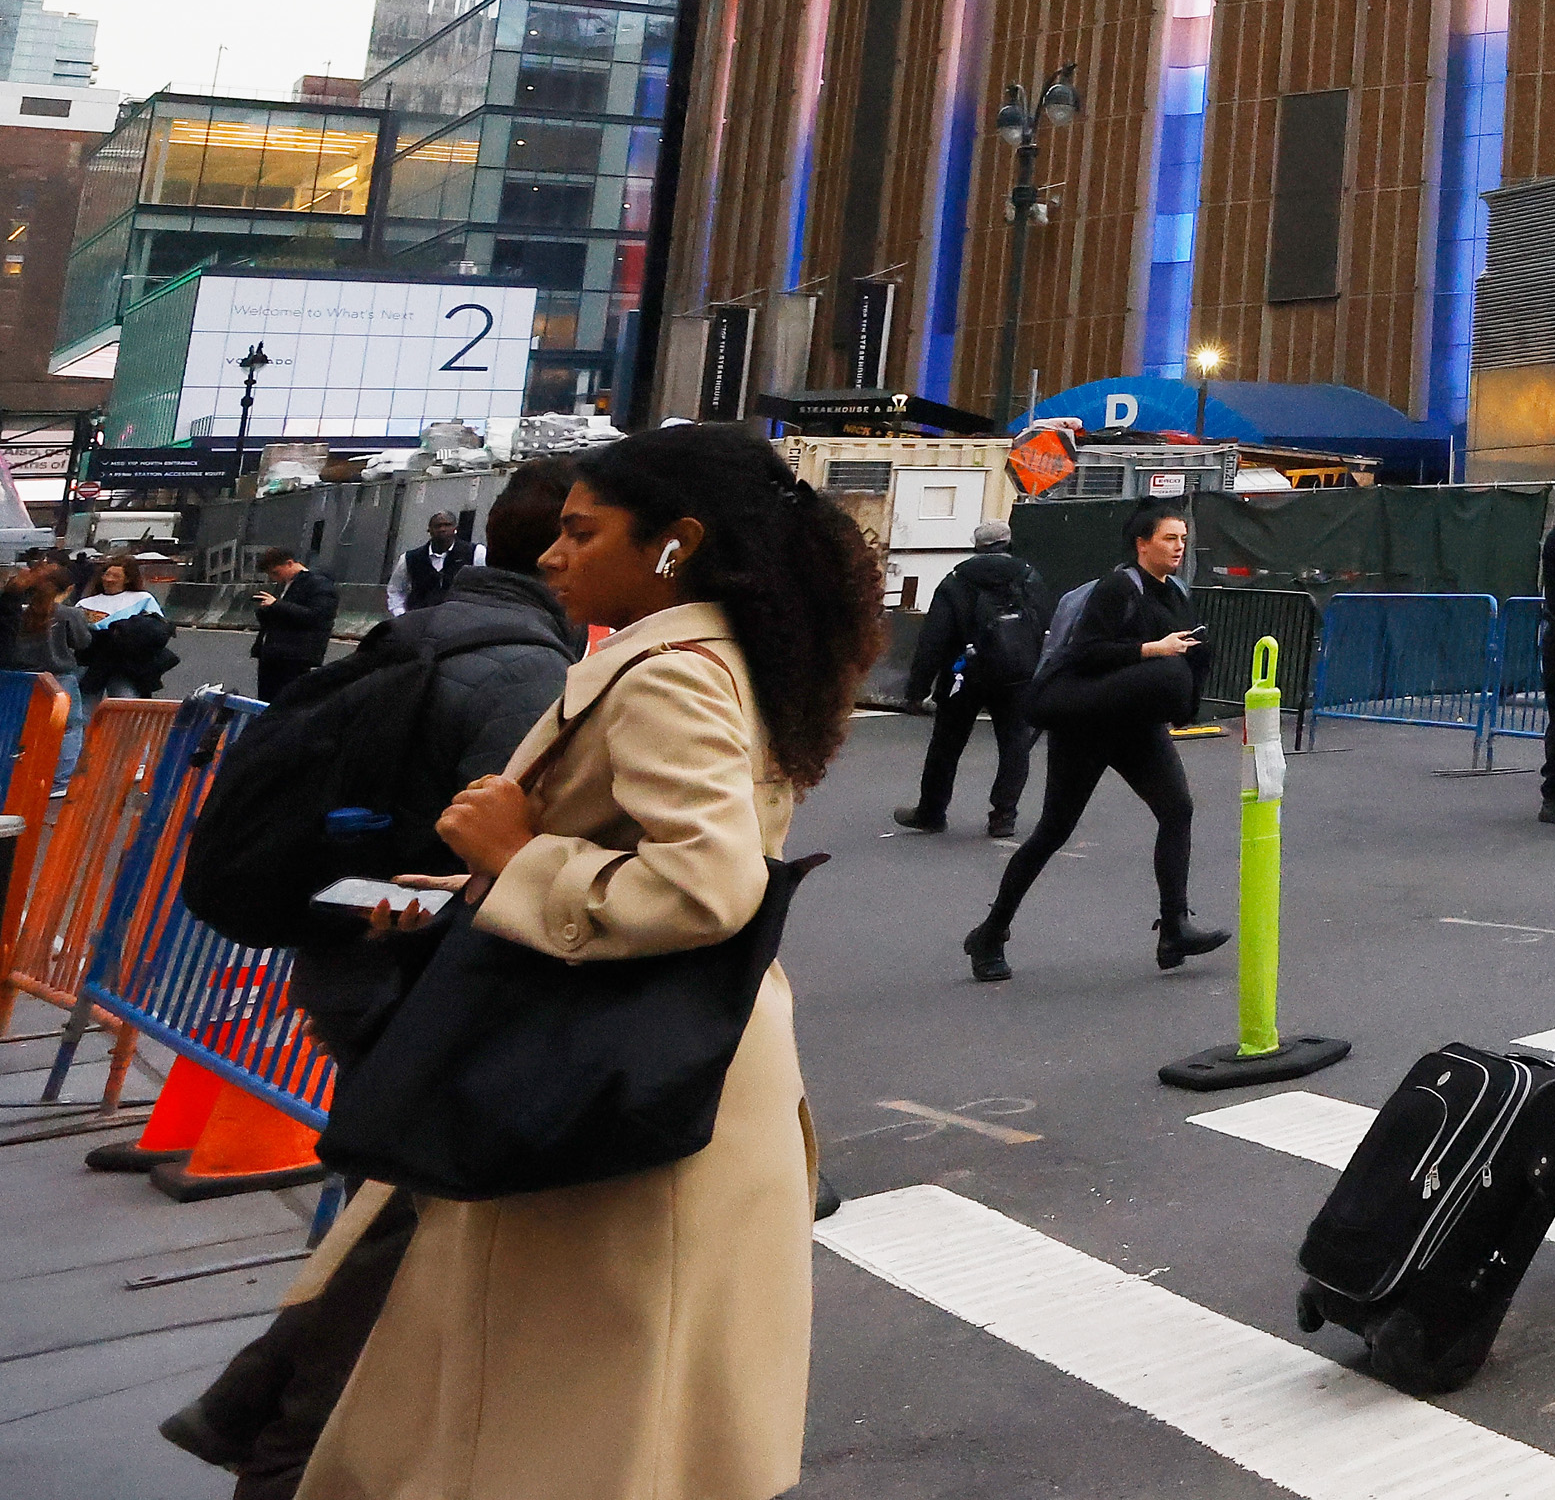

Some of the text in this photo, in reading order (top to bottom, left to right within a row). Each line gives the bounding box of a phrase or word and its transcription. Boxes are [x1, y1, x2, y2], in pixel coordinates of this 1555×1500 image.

[231, 304, 415, 321] Welcome to What's Next
[437, 302, 494, 372] 2
[799, 405, 870, 415] STEAKHOUSE
[1104, 393, 1139, 429] D
